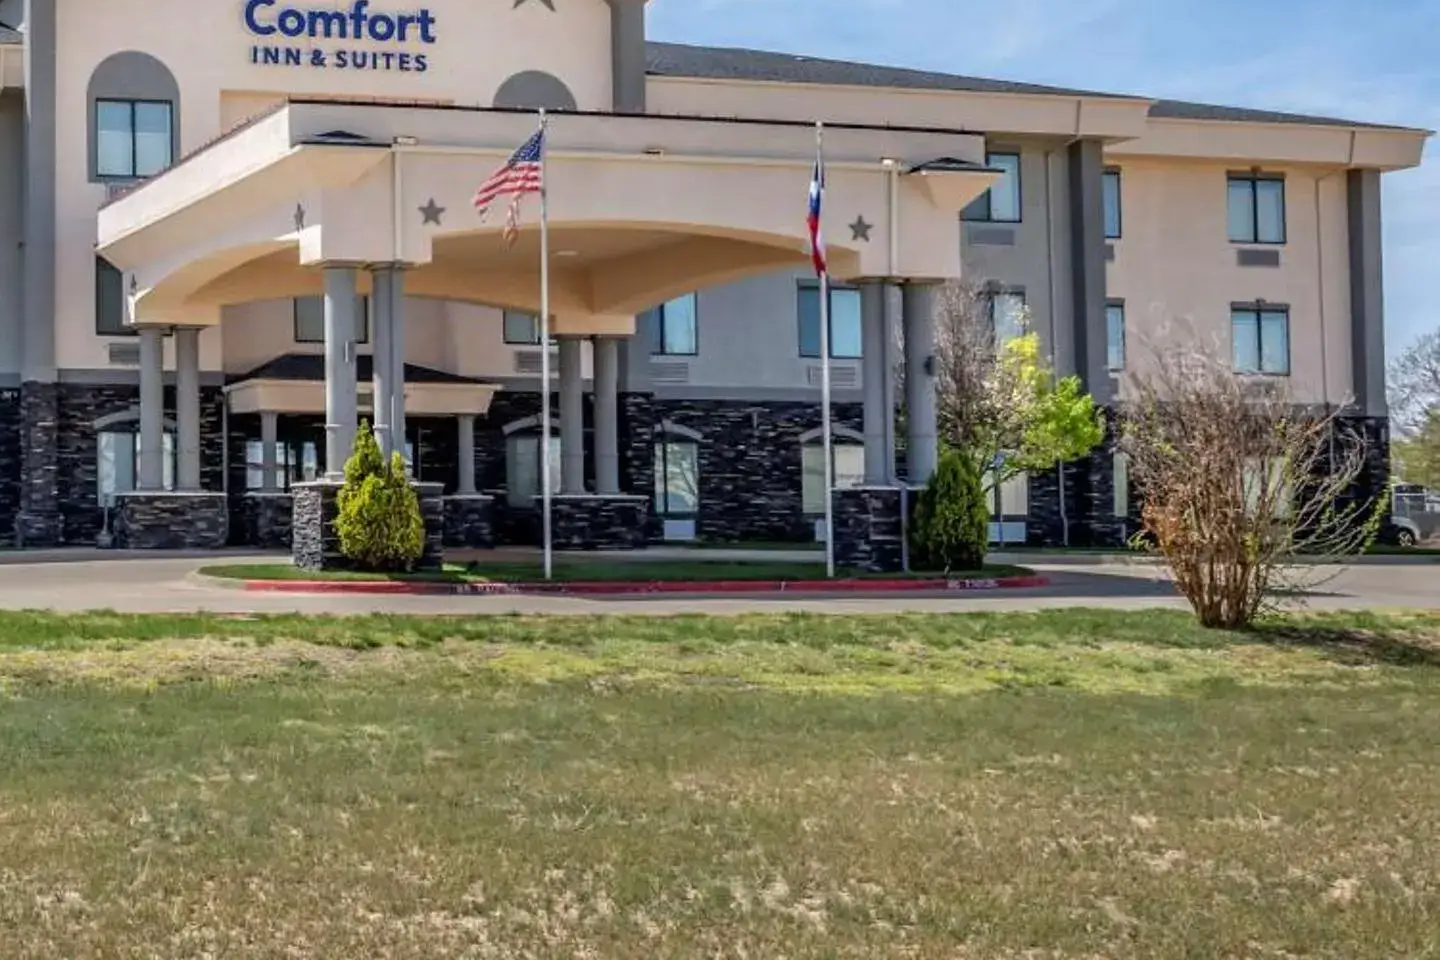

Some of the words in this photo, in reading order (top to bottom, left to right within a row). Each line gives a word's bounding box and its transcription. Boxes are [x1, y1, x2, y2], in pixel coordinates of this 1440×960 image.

[252, 46, 301, 66] INN
[310, 49, 327, 67] &
[335, 50, 427, 72] SUITES
